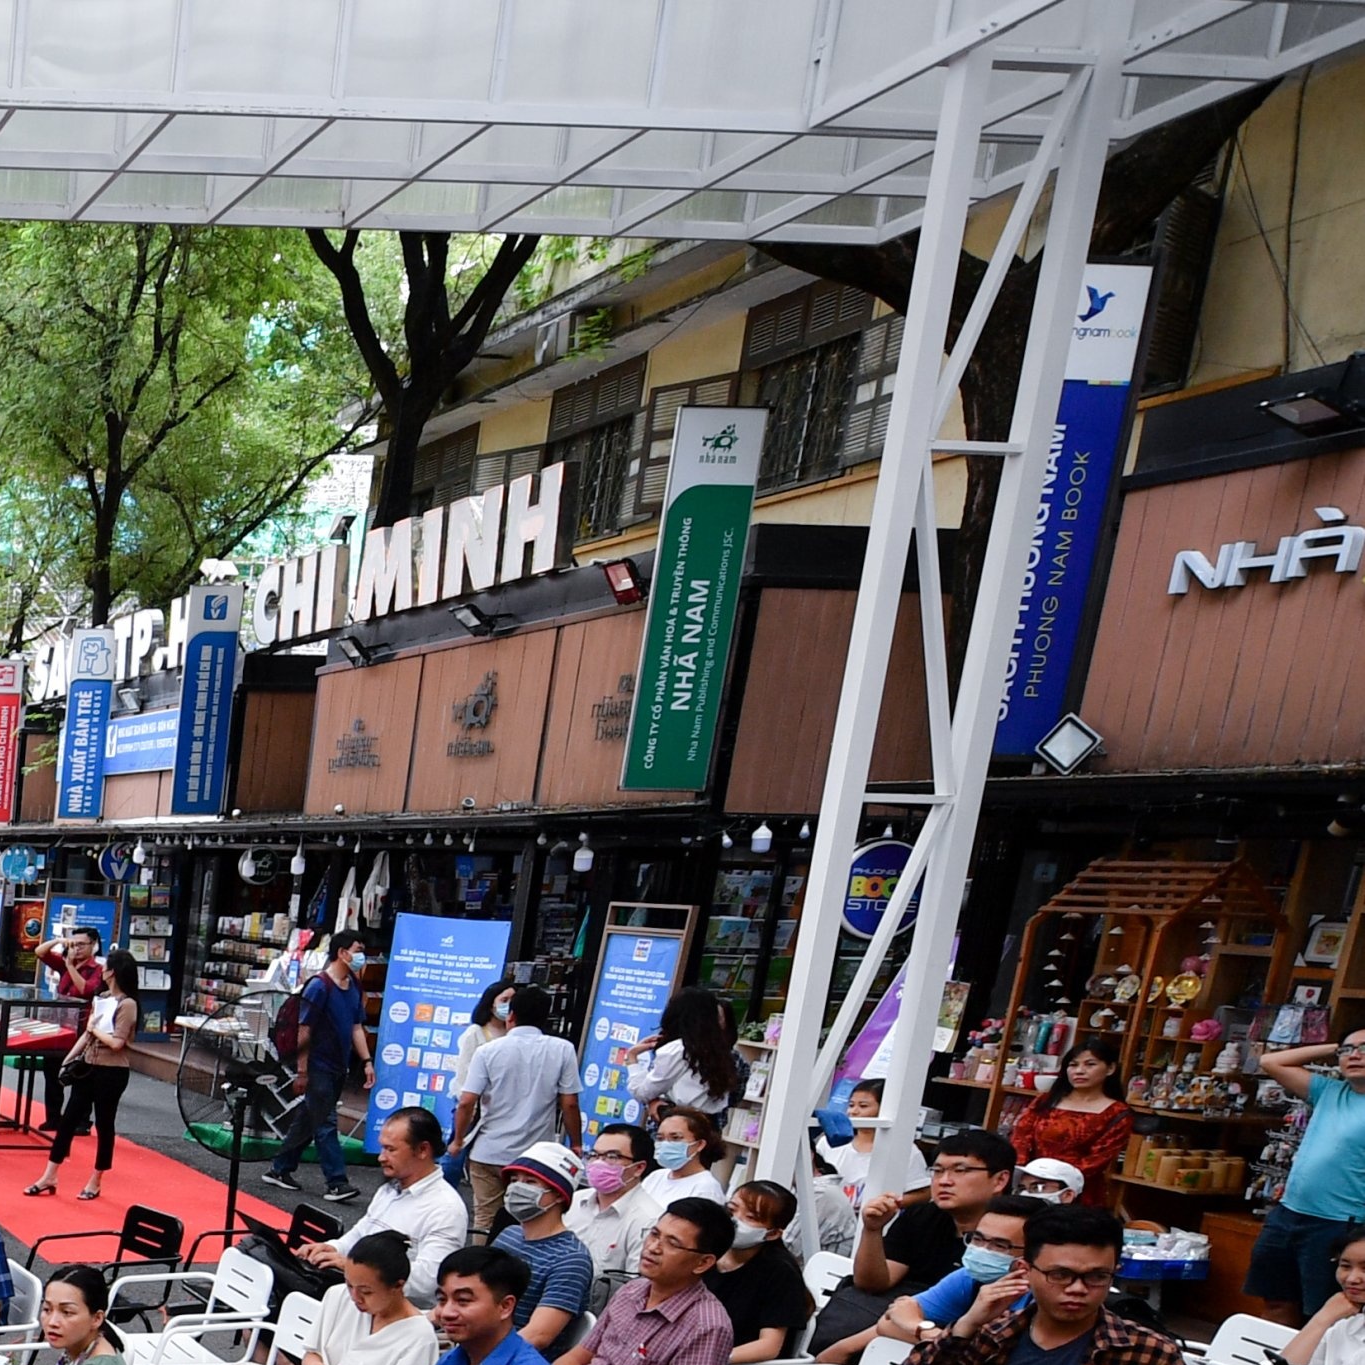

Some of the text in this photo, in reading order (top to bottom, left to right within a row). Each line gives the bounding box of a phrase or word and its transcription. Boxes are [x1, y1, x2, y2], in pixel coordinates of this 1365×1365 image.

[353, 461, 572, 622] MINH
[1023, 450, 1091, 698] PHUONG NAM BOOK
[1167, 506, 1365, 595] NHÀ
[643, 517, 693, 770] CÔNG TY CỔ PHẦN VĂN HOÁ & TRUYỀN THÔNG
[670, 579, 711, 711] NHÃ NAM
[686, 527, 735, 762] Nha Nam Publishing and Communications JSC.
[66, 690, 93, 813] NHÀ XUẤT BẢN TRẺ
[846, 898, 918, 913] STOE
[849, 875, 901, 899] BOO
